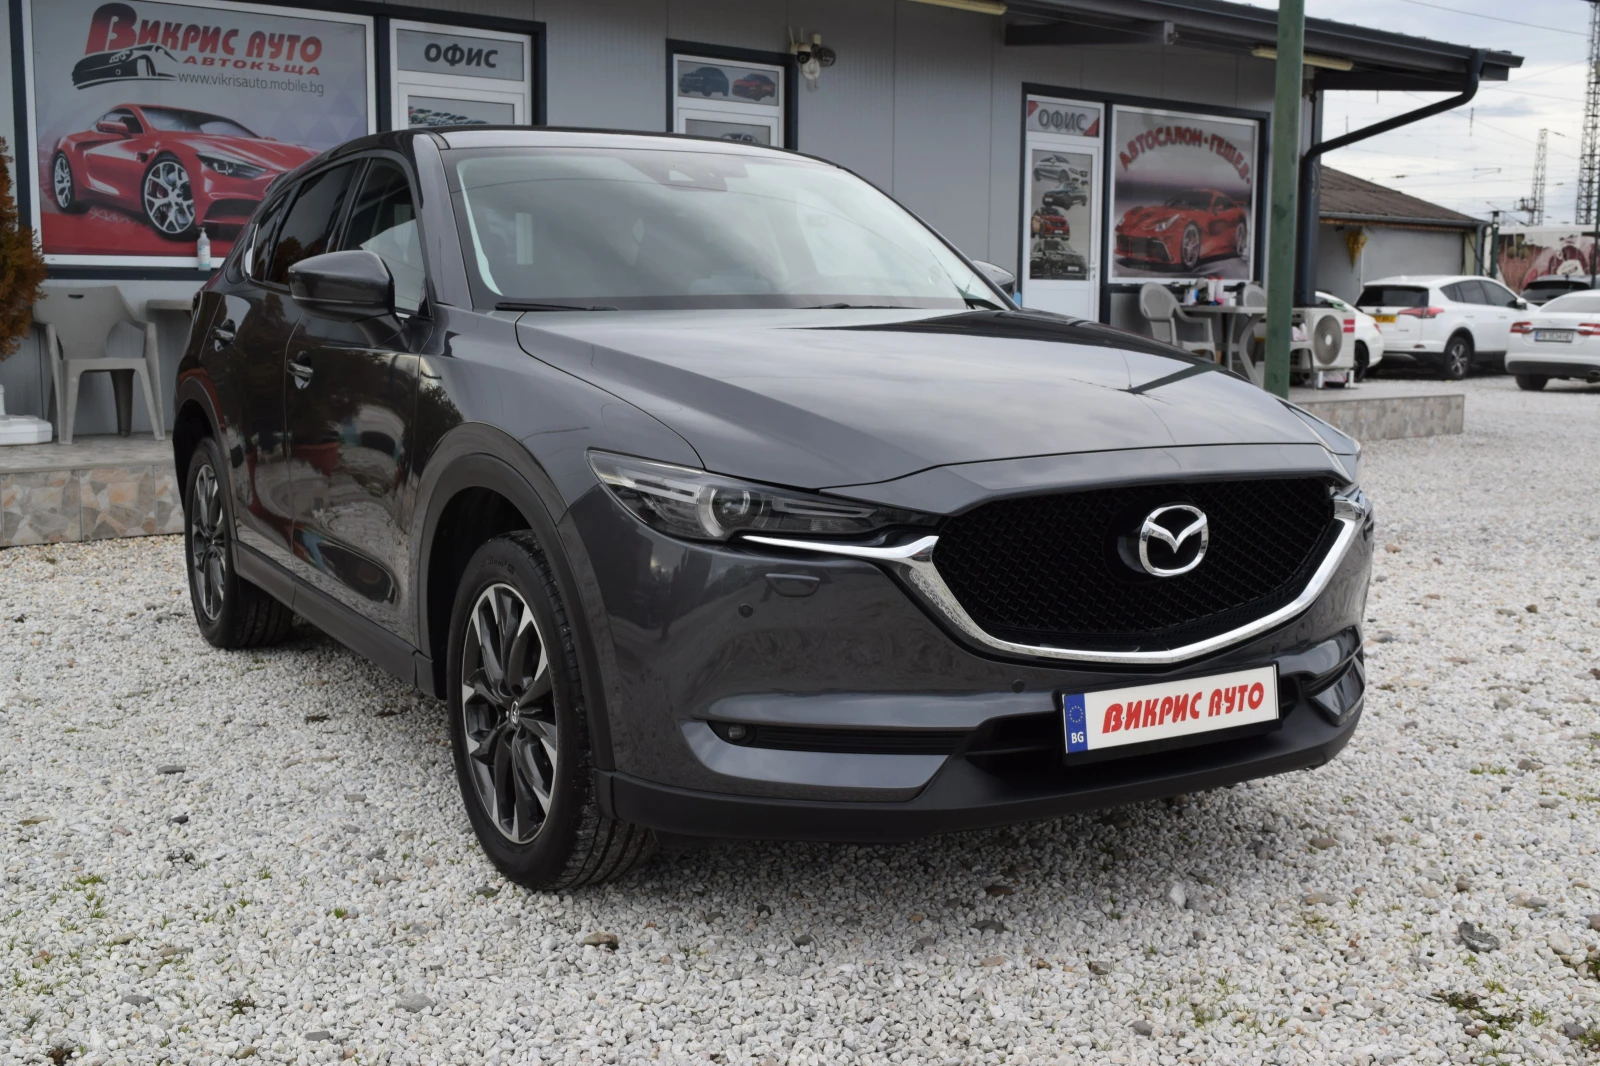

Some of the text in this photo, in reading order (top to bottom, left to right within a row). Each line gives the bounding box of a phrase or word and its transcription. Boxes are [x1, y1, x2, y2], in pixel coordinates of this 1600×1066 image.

[85, 2, 323, 63] ВИКРИС АУТО
[182, 55, 321, 76] АВТОКЪЩА
[424, 43, 498, 68] ОФИС
[178, 72, 325, 97] www.vikrisauto.mobile.bg
[1039, 109, 1088, 132] ОФИС
[1102, 682, 1265, 734] ВИКРИС АУТО
[1071, 731, 1084, 744] BG
